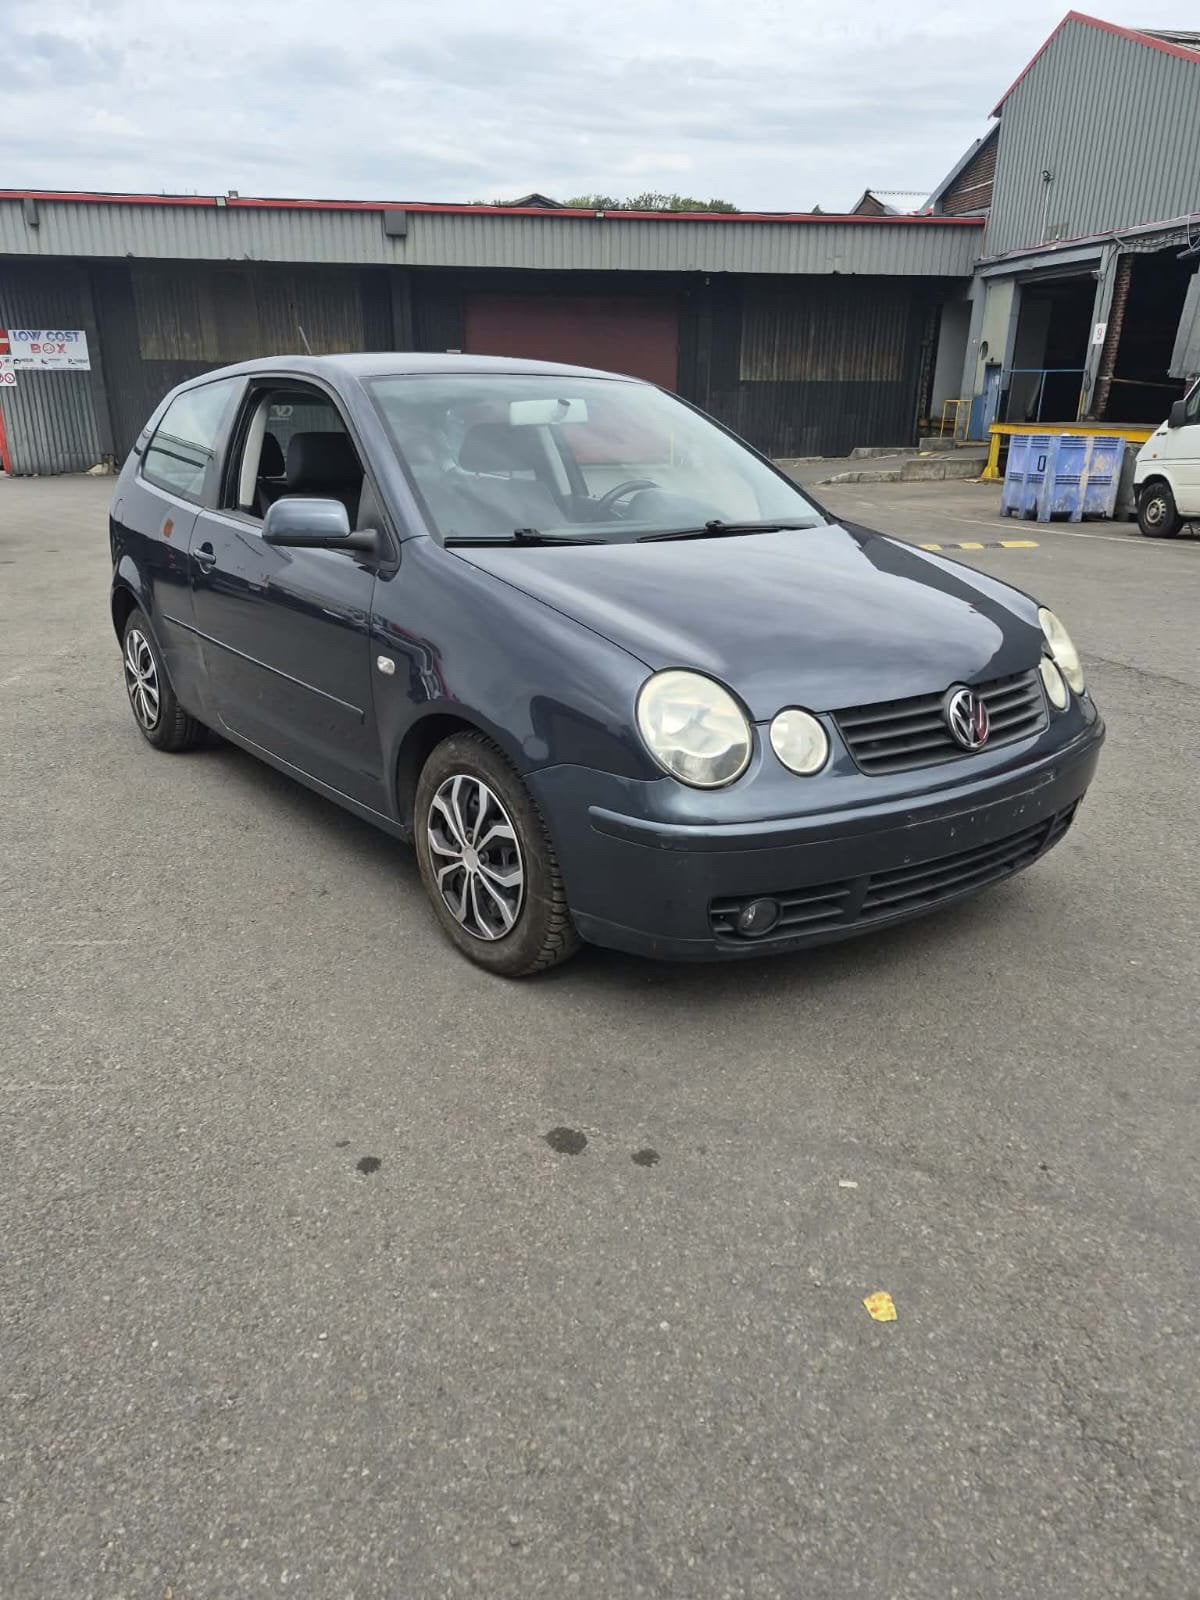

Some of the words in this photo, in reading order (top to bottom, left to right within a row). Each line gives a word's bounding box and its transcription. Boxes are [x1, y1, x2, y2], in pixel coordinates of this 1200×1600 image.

[13, 331, 41, 342] LOW
[46, 331, 80, 342] COST
[30, 342, 66, 354] BOX
